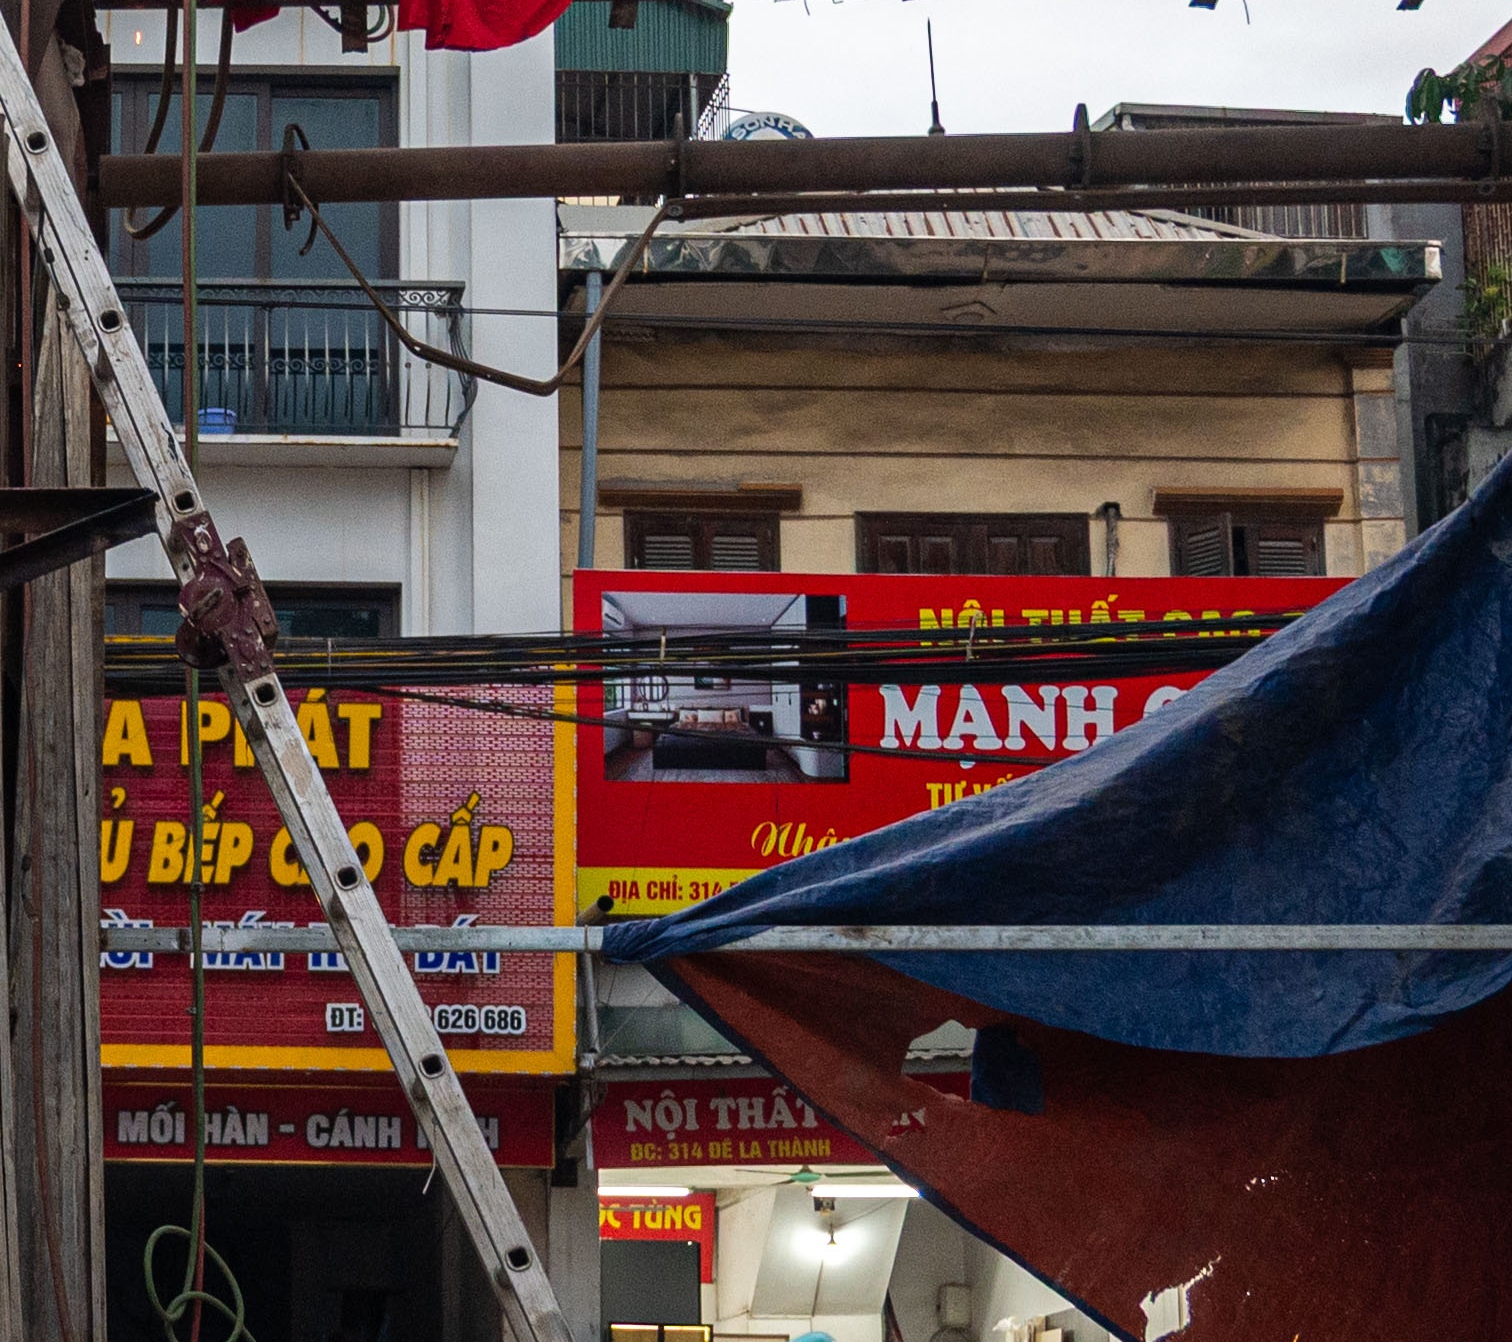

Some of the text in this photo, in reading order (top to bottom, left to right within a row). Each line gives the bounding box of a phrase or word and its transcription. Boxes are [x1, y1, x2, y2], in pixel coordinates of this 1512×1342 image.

[879, 684, 1118, 769] MẠNH
[148, 790, 255, 885] BẾP
[403, 791, 514, 888] CẤP
[608, 880, 640, 904] ĐỊA
[646, 874, 683, 900] CHỈ:
[328, 1005, 524, 1032] ĐT: 626 686
[305, 1108, 401, 1149] CÁNH
[624, 1089, 700, 1141] NỘI
[668, 1141, 703, 1160] 314
[739, 1141, 762, 1159] LA
[767, 1136, 832, 1159] THÀNH
